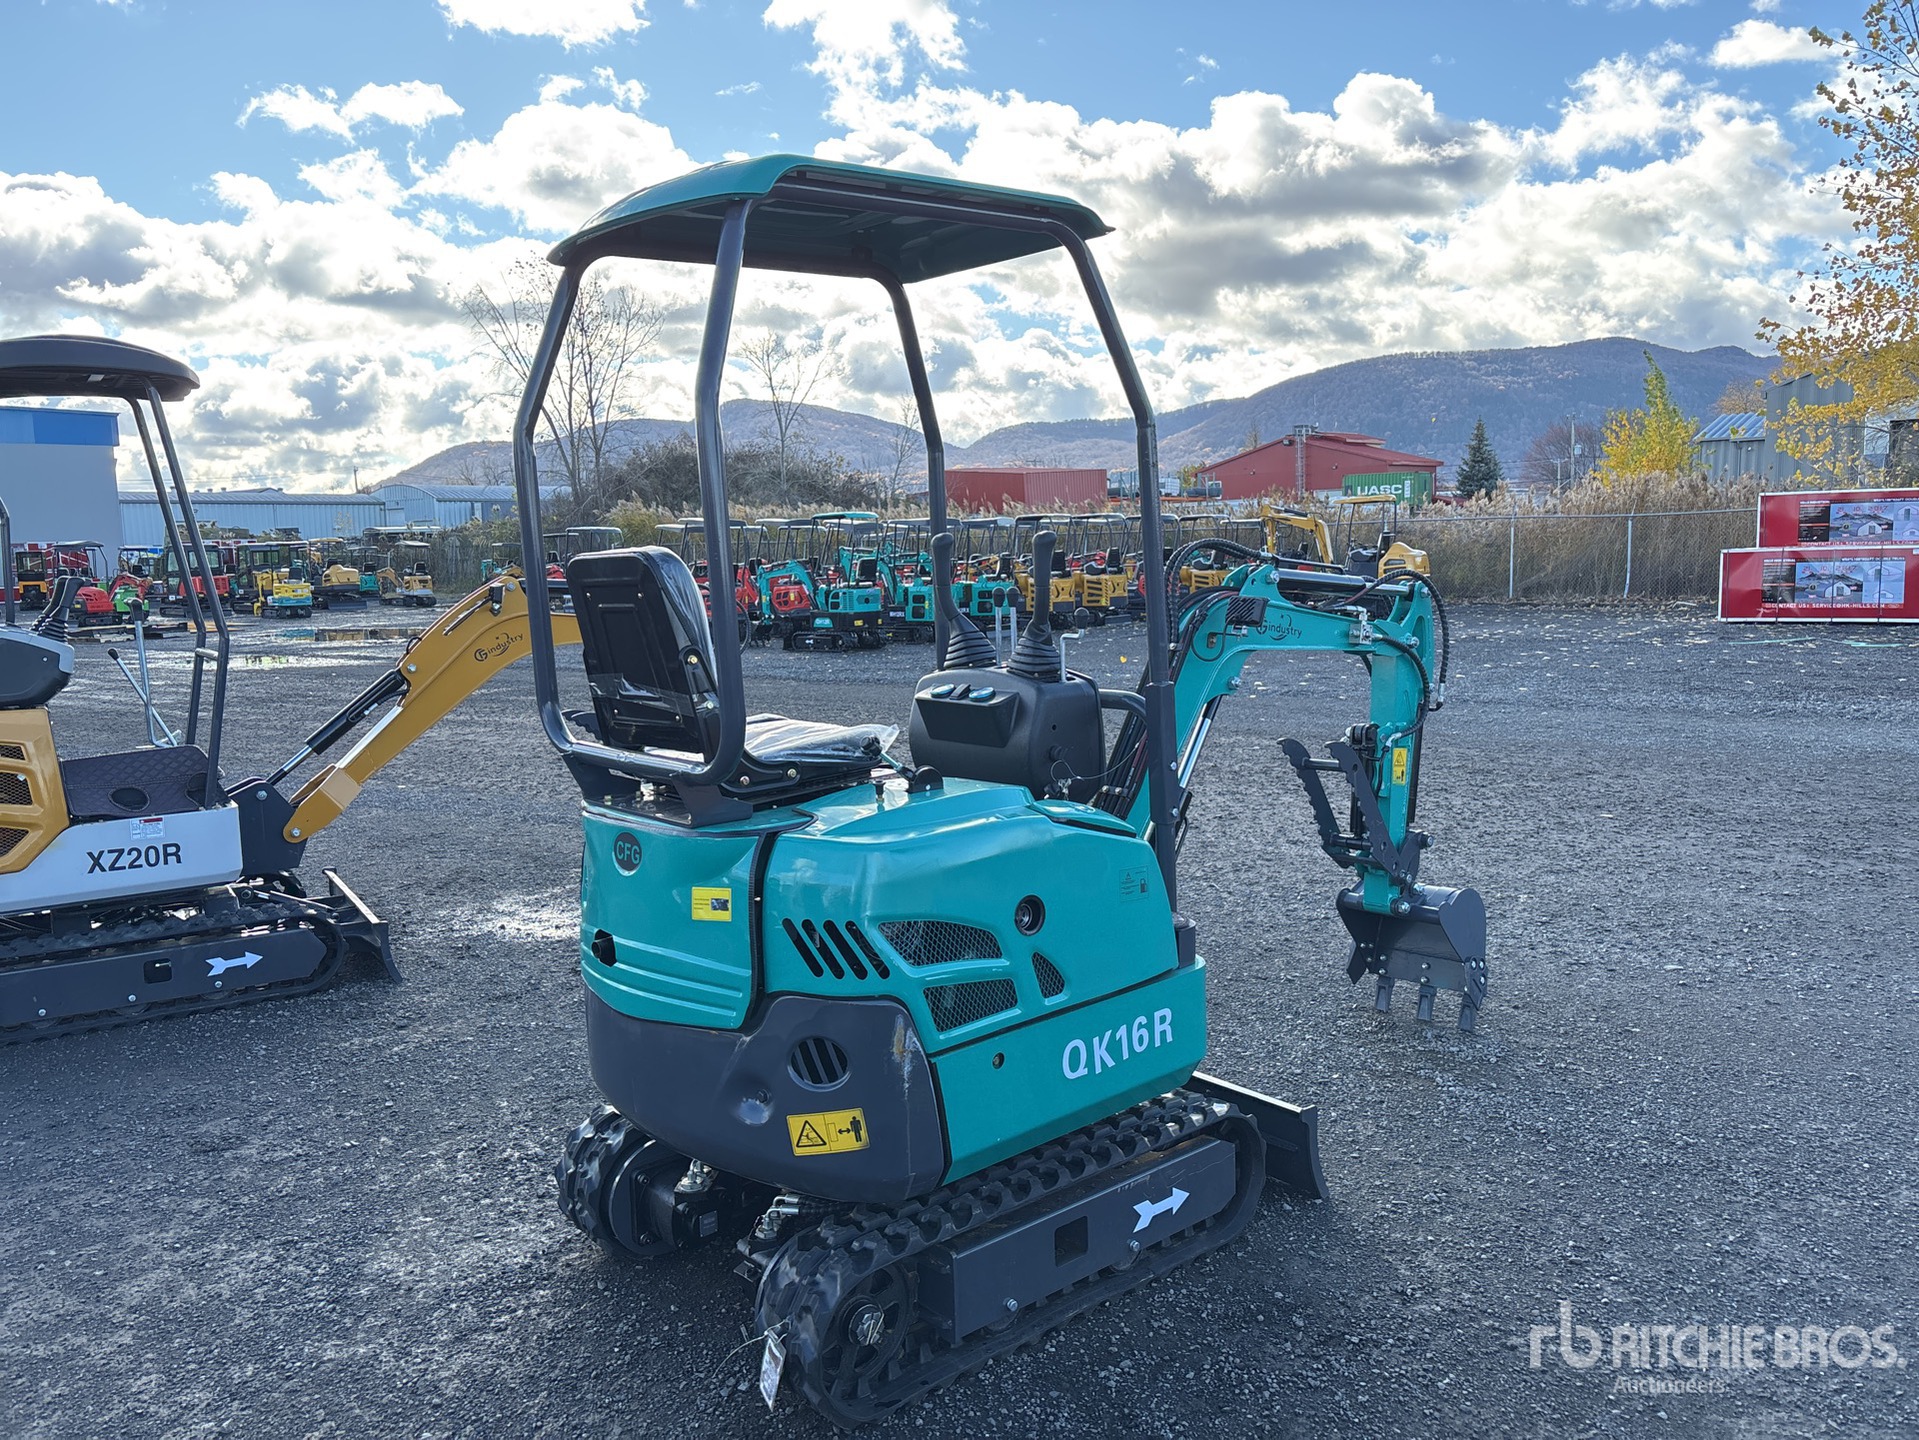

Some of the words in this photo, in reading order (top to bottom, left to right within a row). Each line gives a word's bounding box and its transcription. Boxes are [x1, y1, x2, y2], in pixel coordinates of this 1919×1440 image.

[86, 842, 182, 874] XZ20R
[616, 841, 640, 864] CFG
[1062, 1007, 1173, 1080] QK16R
